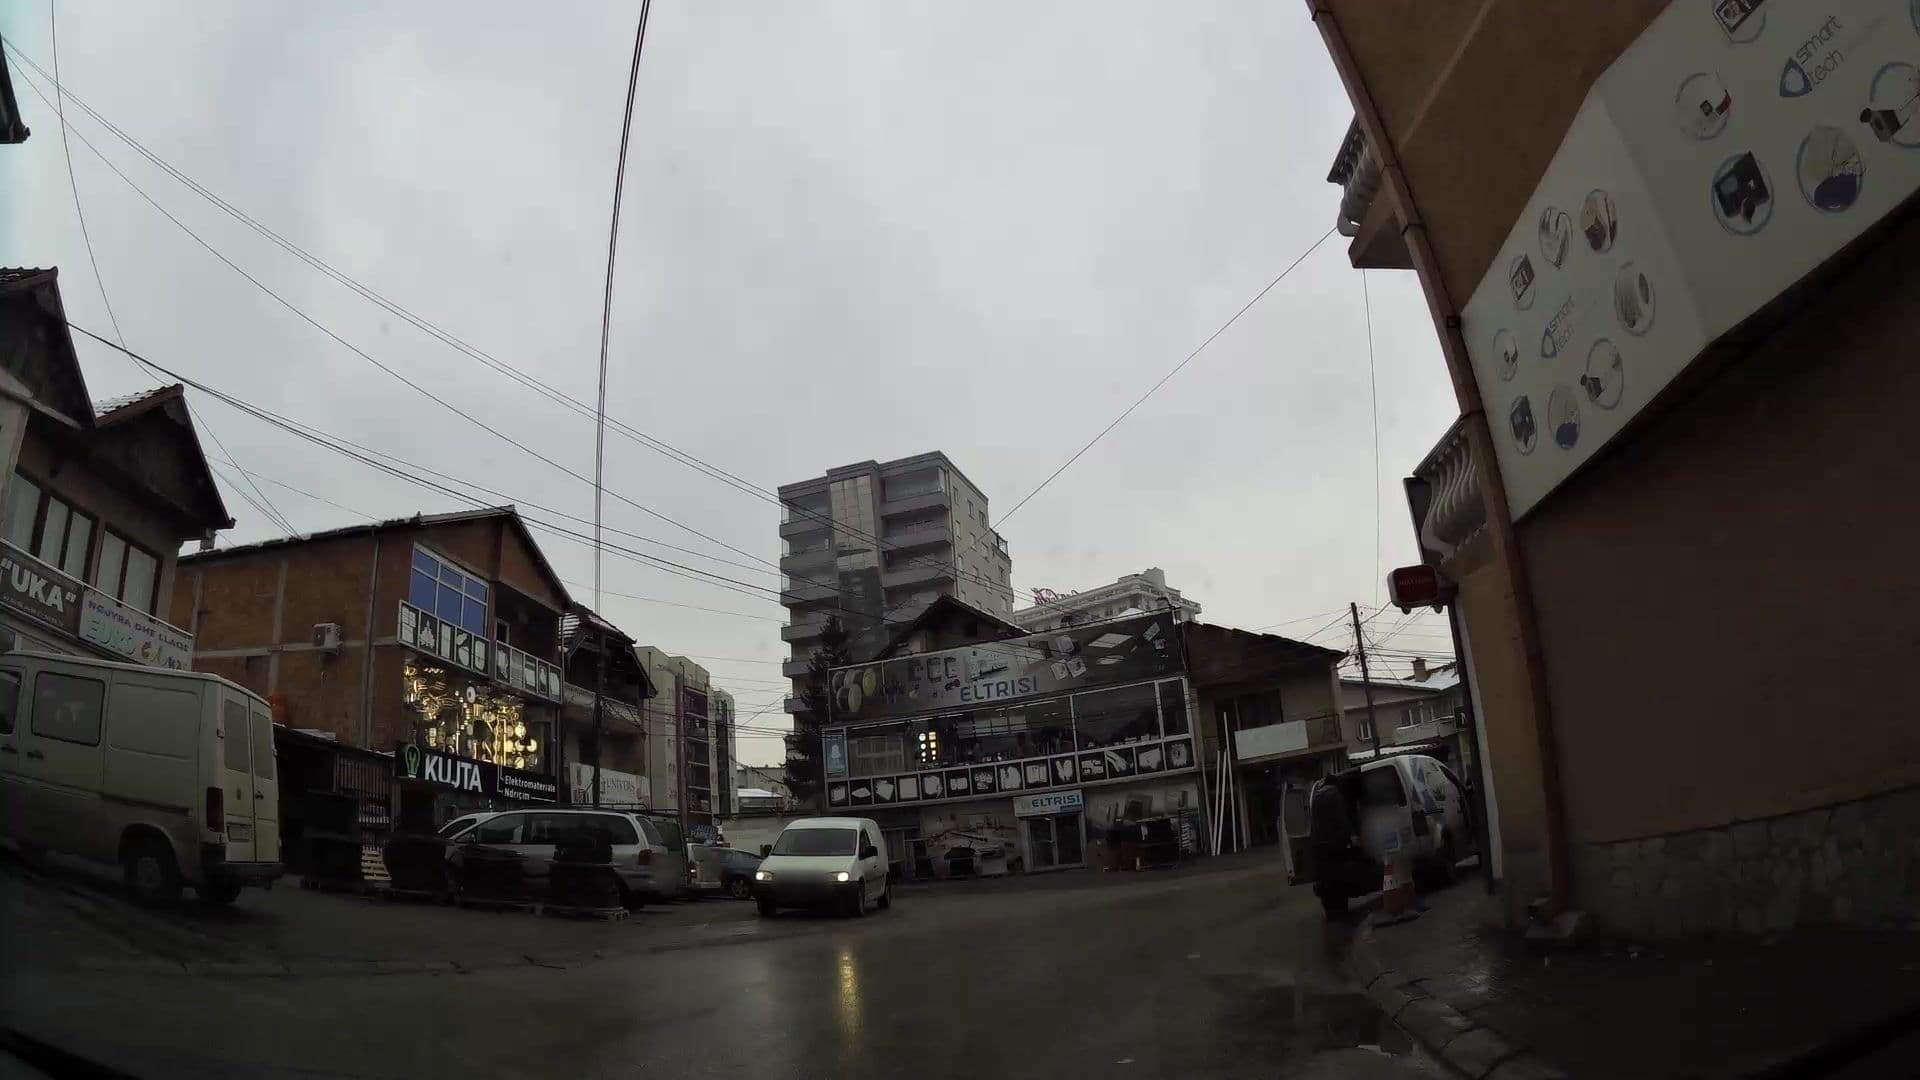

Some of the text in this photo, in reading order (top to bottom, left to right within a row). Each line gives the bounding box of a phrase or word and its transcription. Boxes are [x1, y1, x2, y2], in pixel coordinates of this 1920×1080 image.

[1796, 15, 1842, 65] smart
[1808, 49, 1844, 85] tech
[960, 675, 1037, 702] ELTRISI
[424, 752, 483, 793] KUJTA
[1031, 794, 1080, 808] ELTRISI
